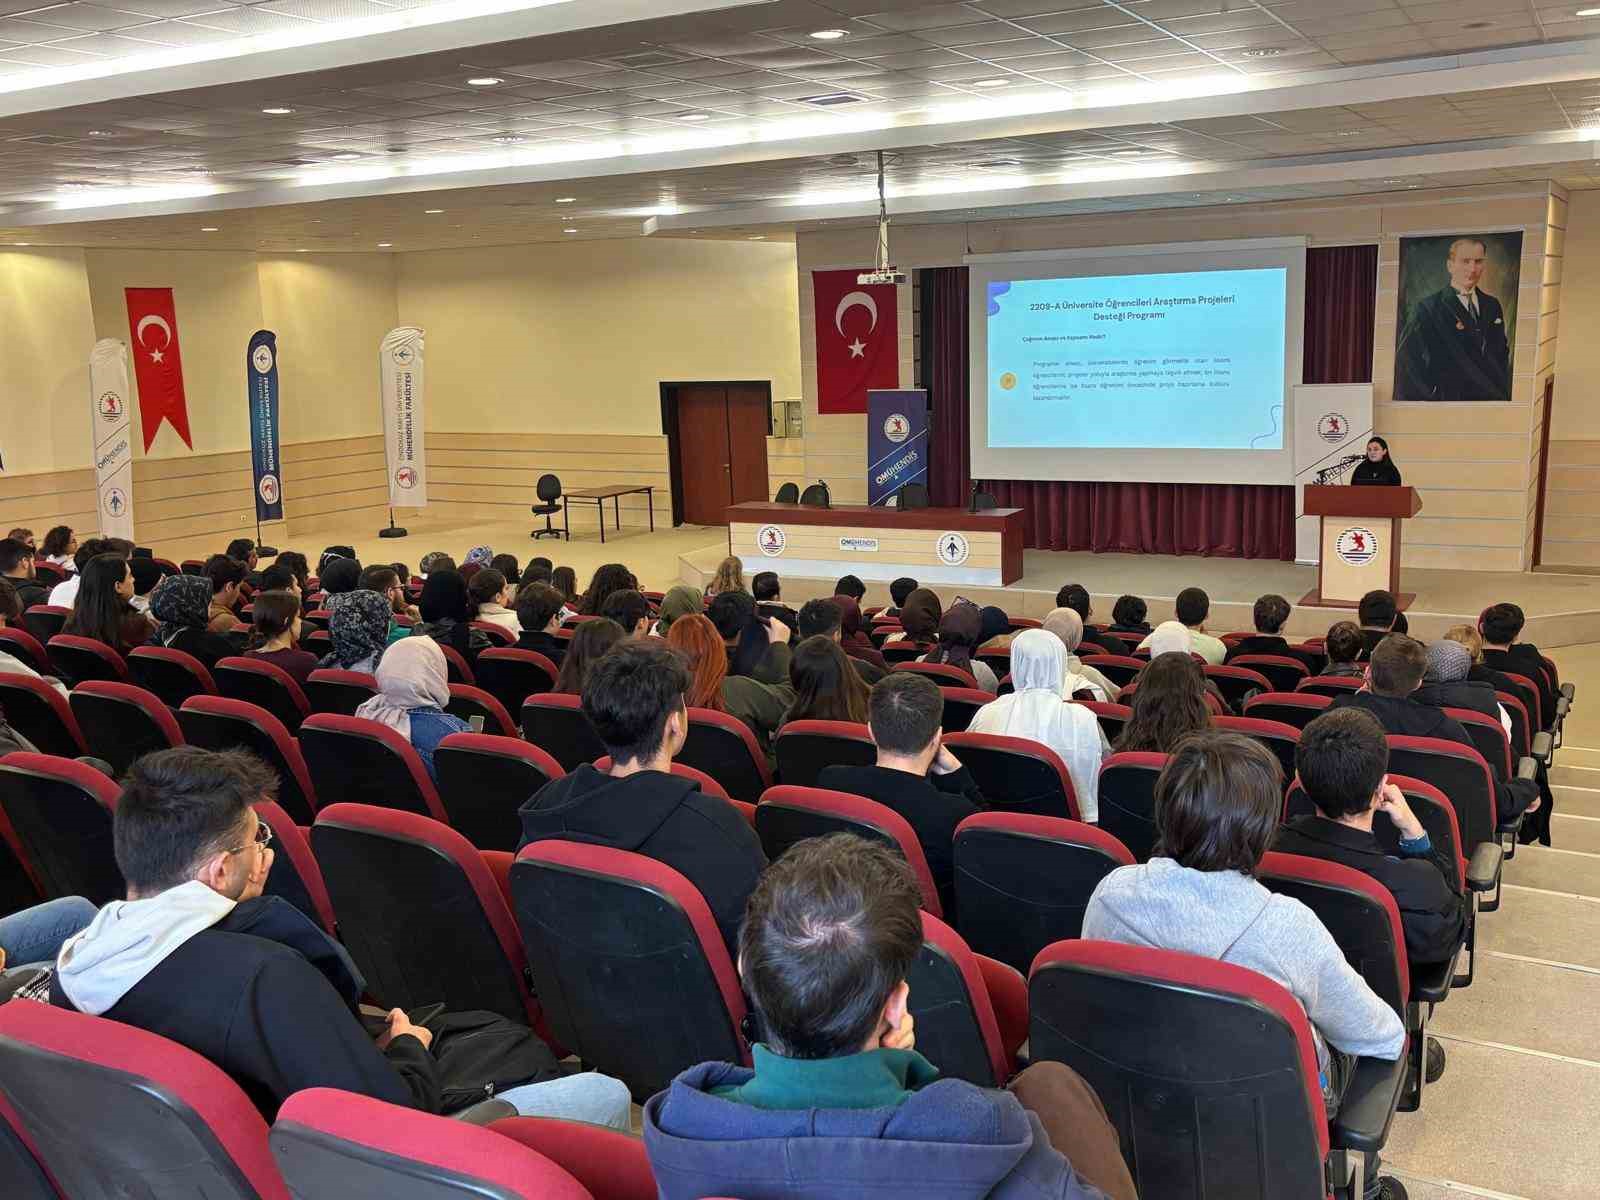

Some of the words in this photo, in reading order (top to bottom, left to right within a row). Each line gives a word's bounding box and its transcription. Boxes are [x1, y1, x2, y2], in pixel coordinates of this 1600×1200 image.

[1029, 302, 1061, 311] 2209-A
[1062, 300, 1104, 310] Üniversite
[1104, 298, 1152, 309] Öğrencileri
[1153, 297, 1197, 307] Araştırma
[1198, 295, 1236, 306] Projeleri
[1093, 312, 1126, 321] Desteği
[1127, 311, 1166, 321] Programı
